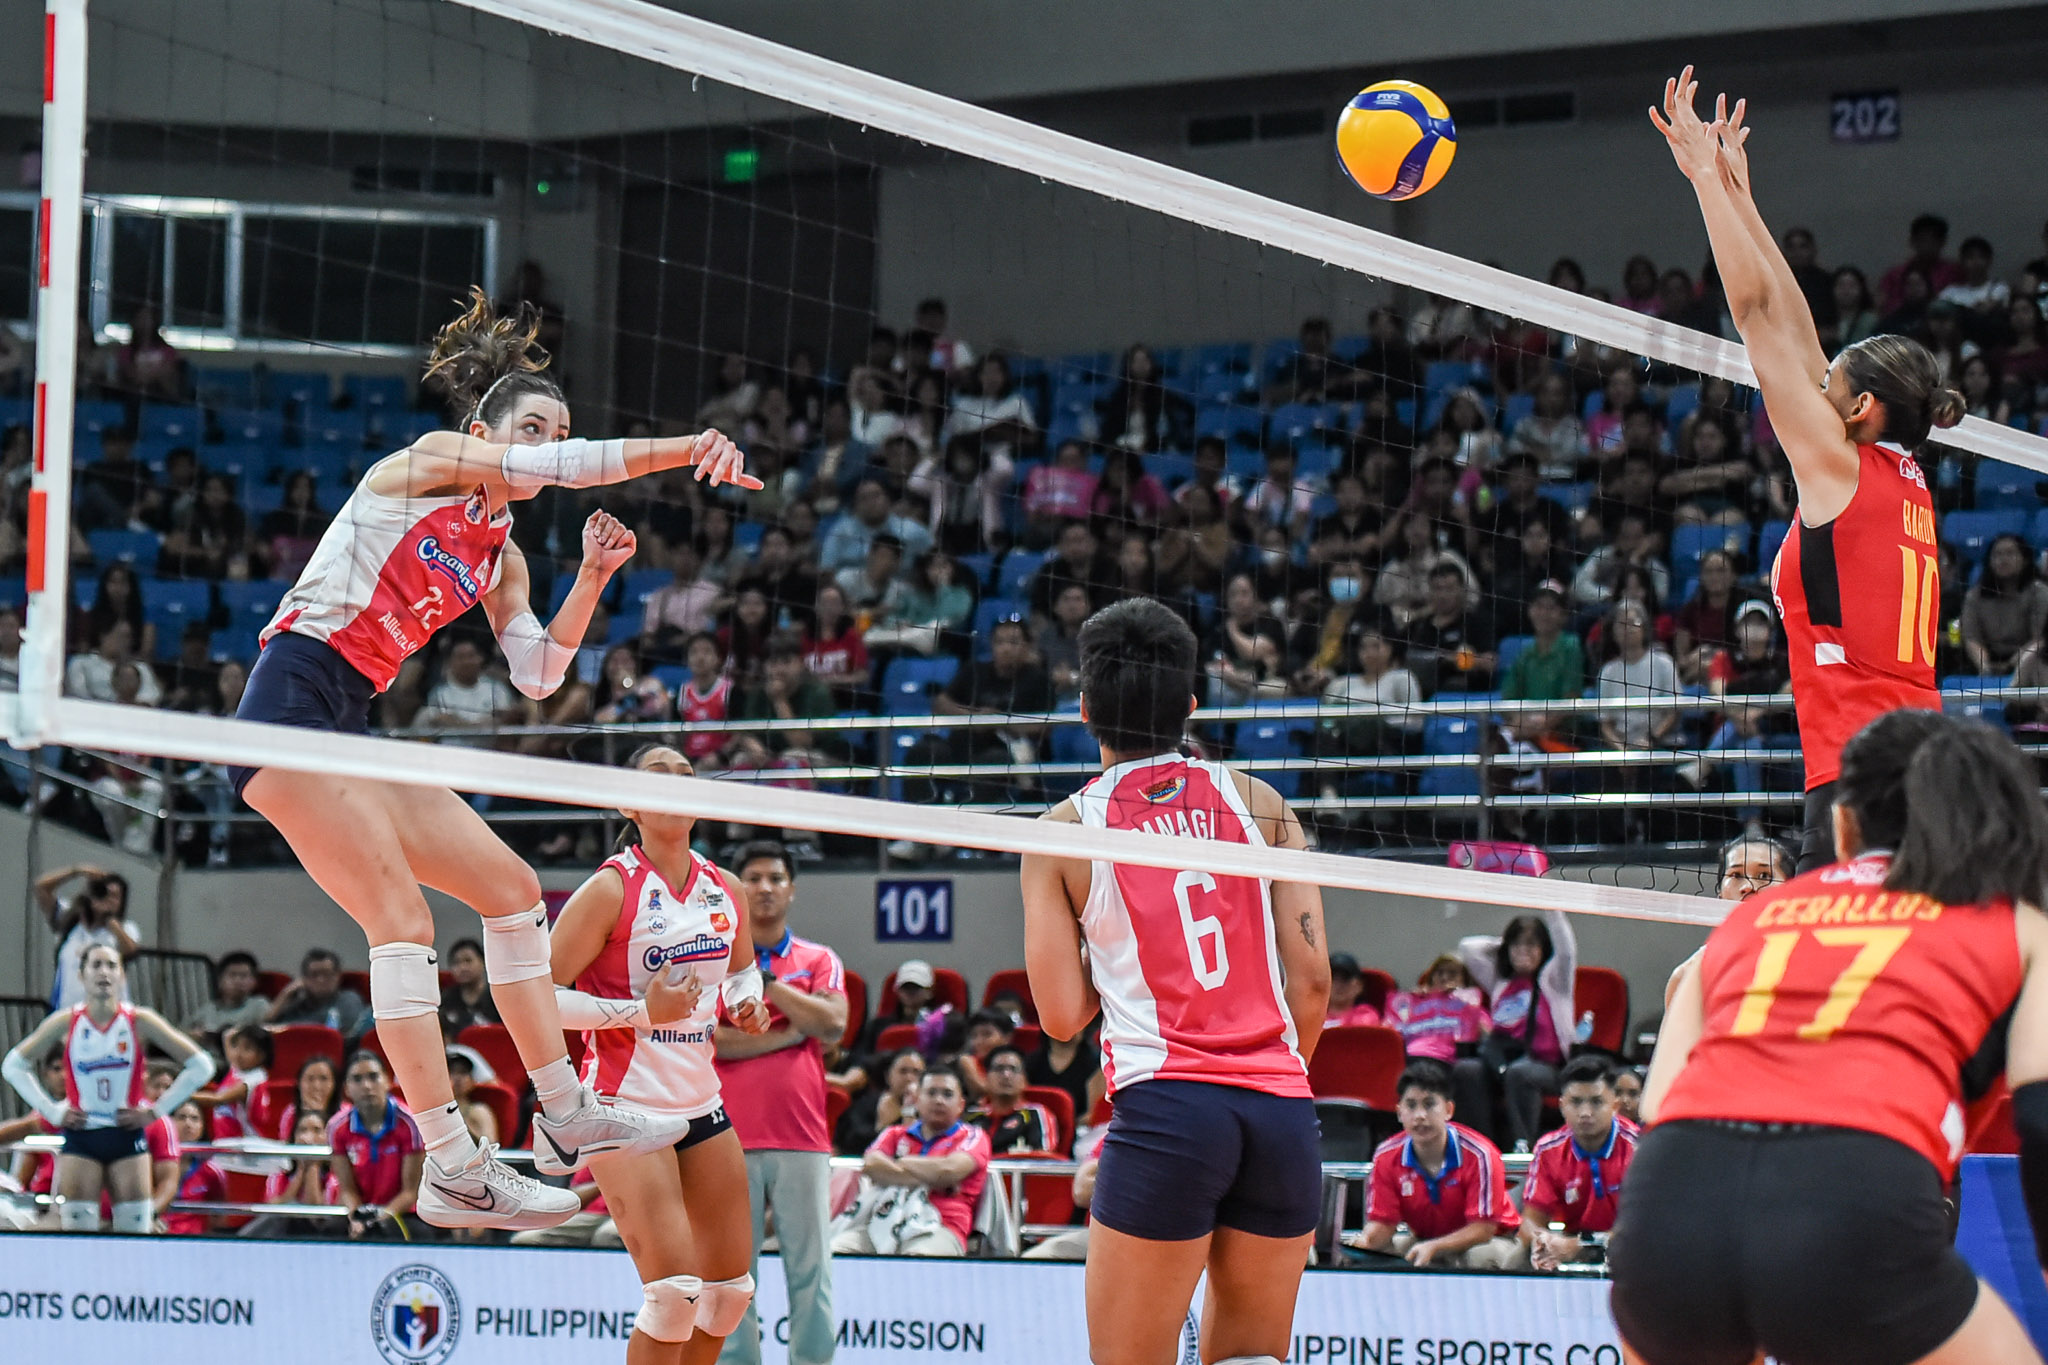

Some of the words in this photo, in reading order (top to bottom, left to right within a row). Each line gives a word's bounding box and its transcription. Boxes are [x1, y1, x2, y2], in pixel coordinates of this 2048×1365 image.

[1834, 97, 1896, 137] 202
[1897, 544, 1939, 668] 10
[880, 886, 948, 934] 101
[1755, 892, 1945, 928] CEBALLOS
[1172, 870, 1230, 992] 6
[644, 935, 724, 972] Creamline
[1731, 926, 1912, 1043] 17
[650, 1029, 704, 1043] Allianz
[72, 1294, 254, 1326] COMMISSION
[1288, 1335, 1404, 1365] IPPINE
[1416, 1338, 1552, 1365] SPORTS
